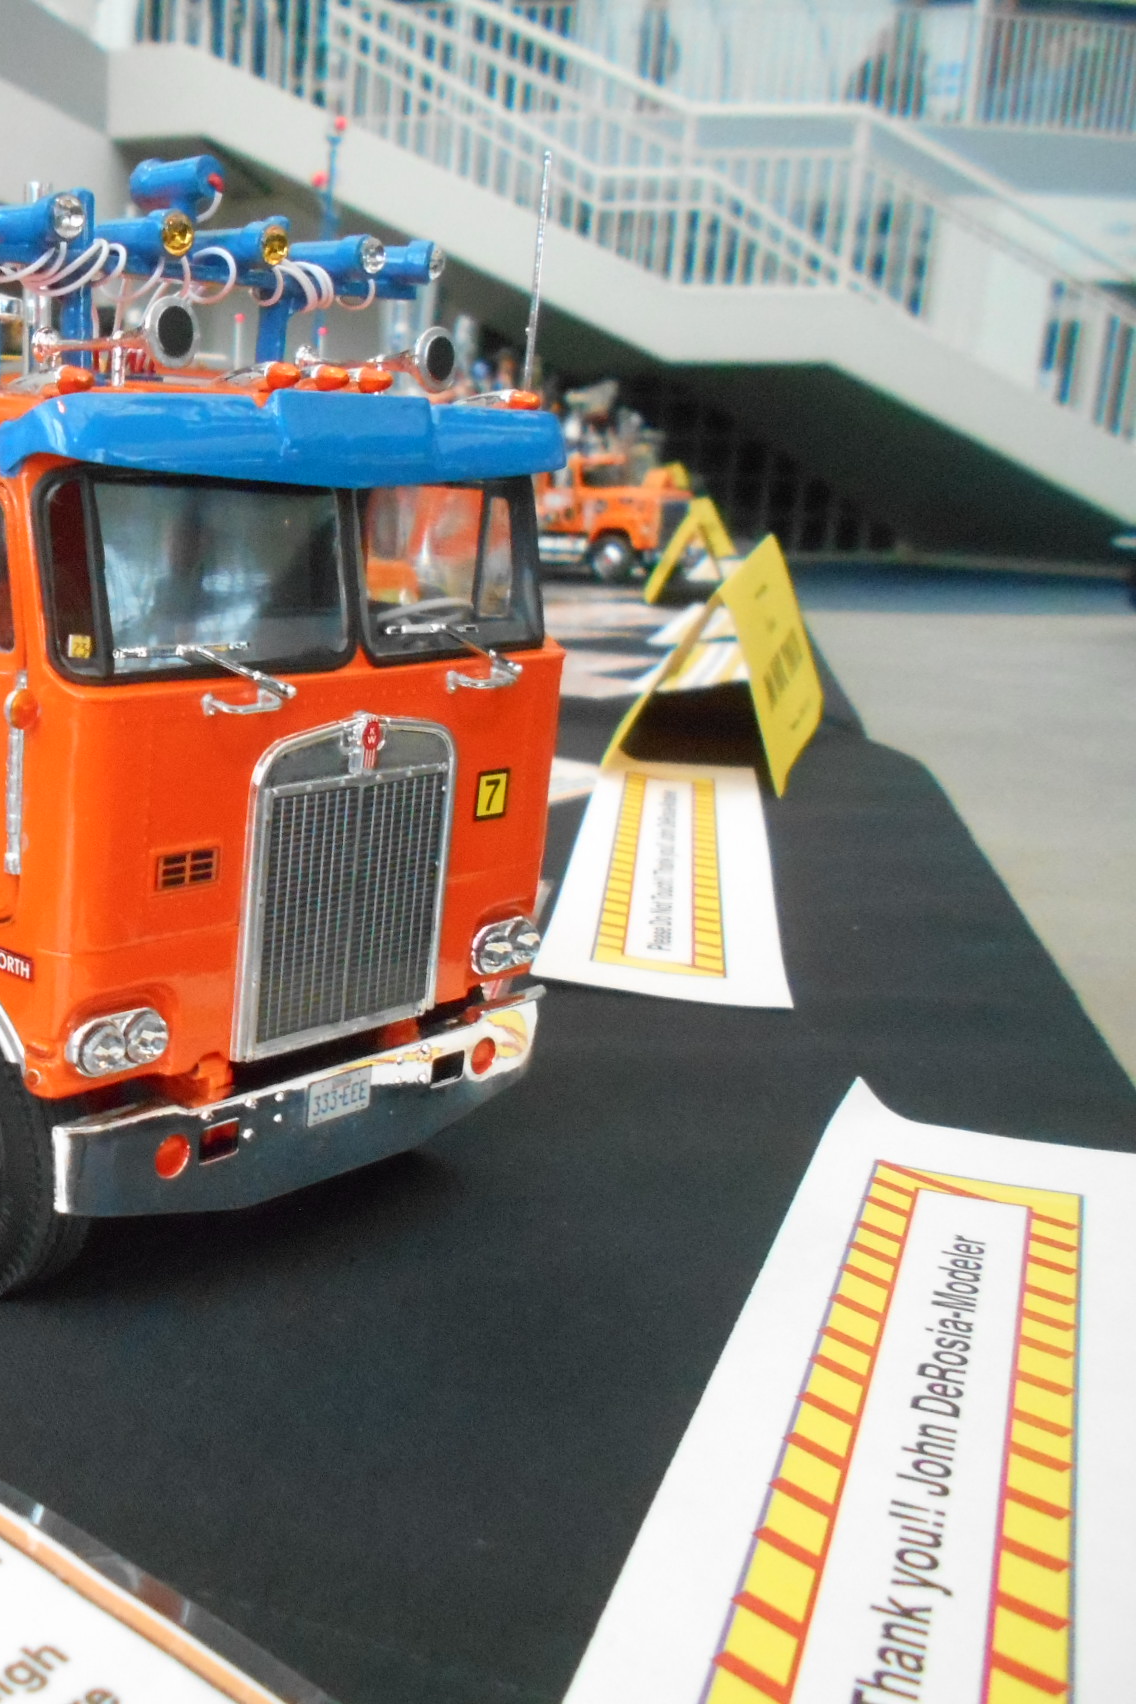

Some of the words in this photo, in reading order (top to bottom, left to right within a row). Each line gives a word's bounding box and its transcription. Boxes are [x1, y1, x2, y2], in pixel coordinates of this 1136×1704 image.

[485, 778, 501, 812] 7
[910, 1234, 986, 1419] DeRosia-Modeler
[896, 1423, 958, 1497] John
[888, 1499, 953, 1597] you!!
